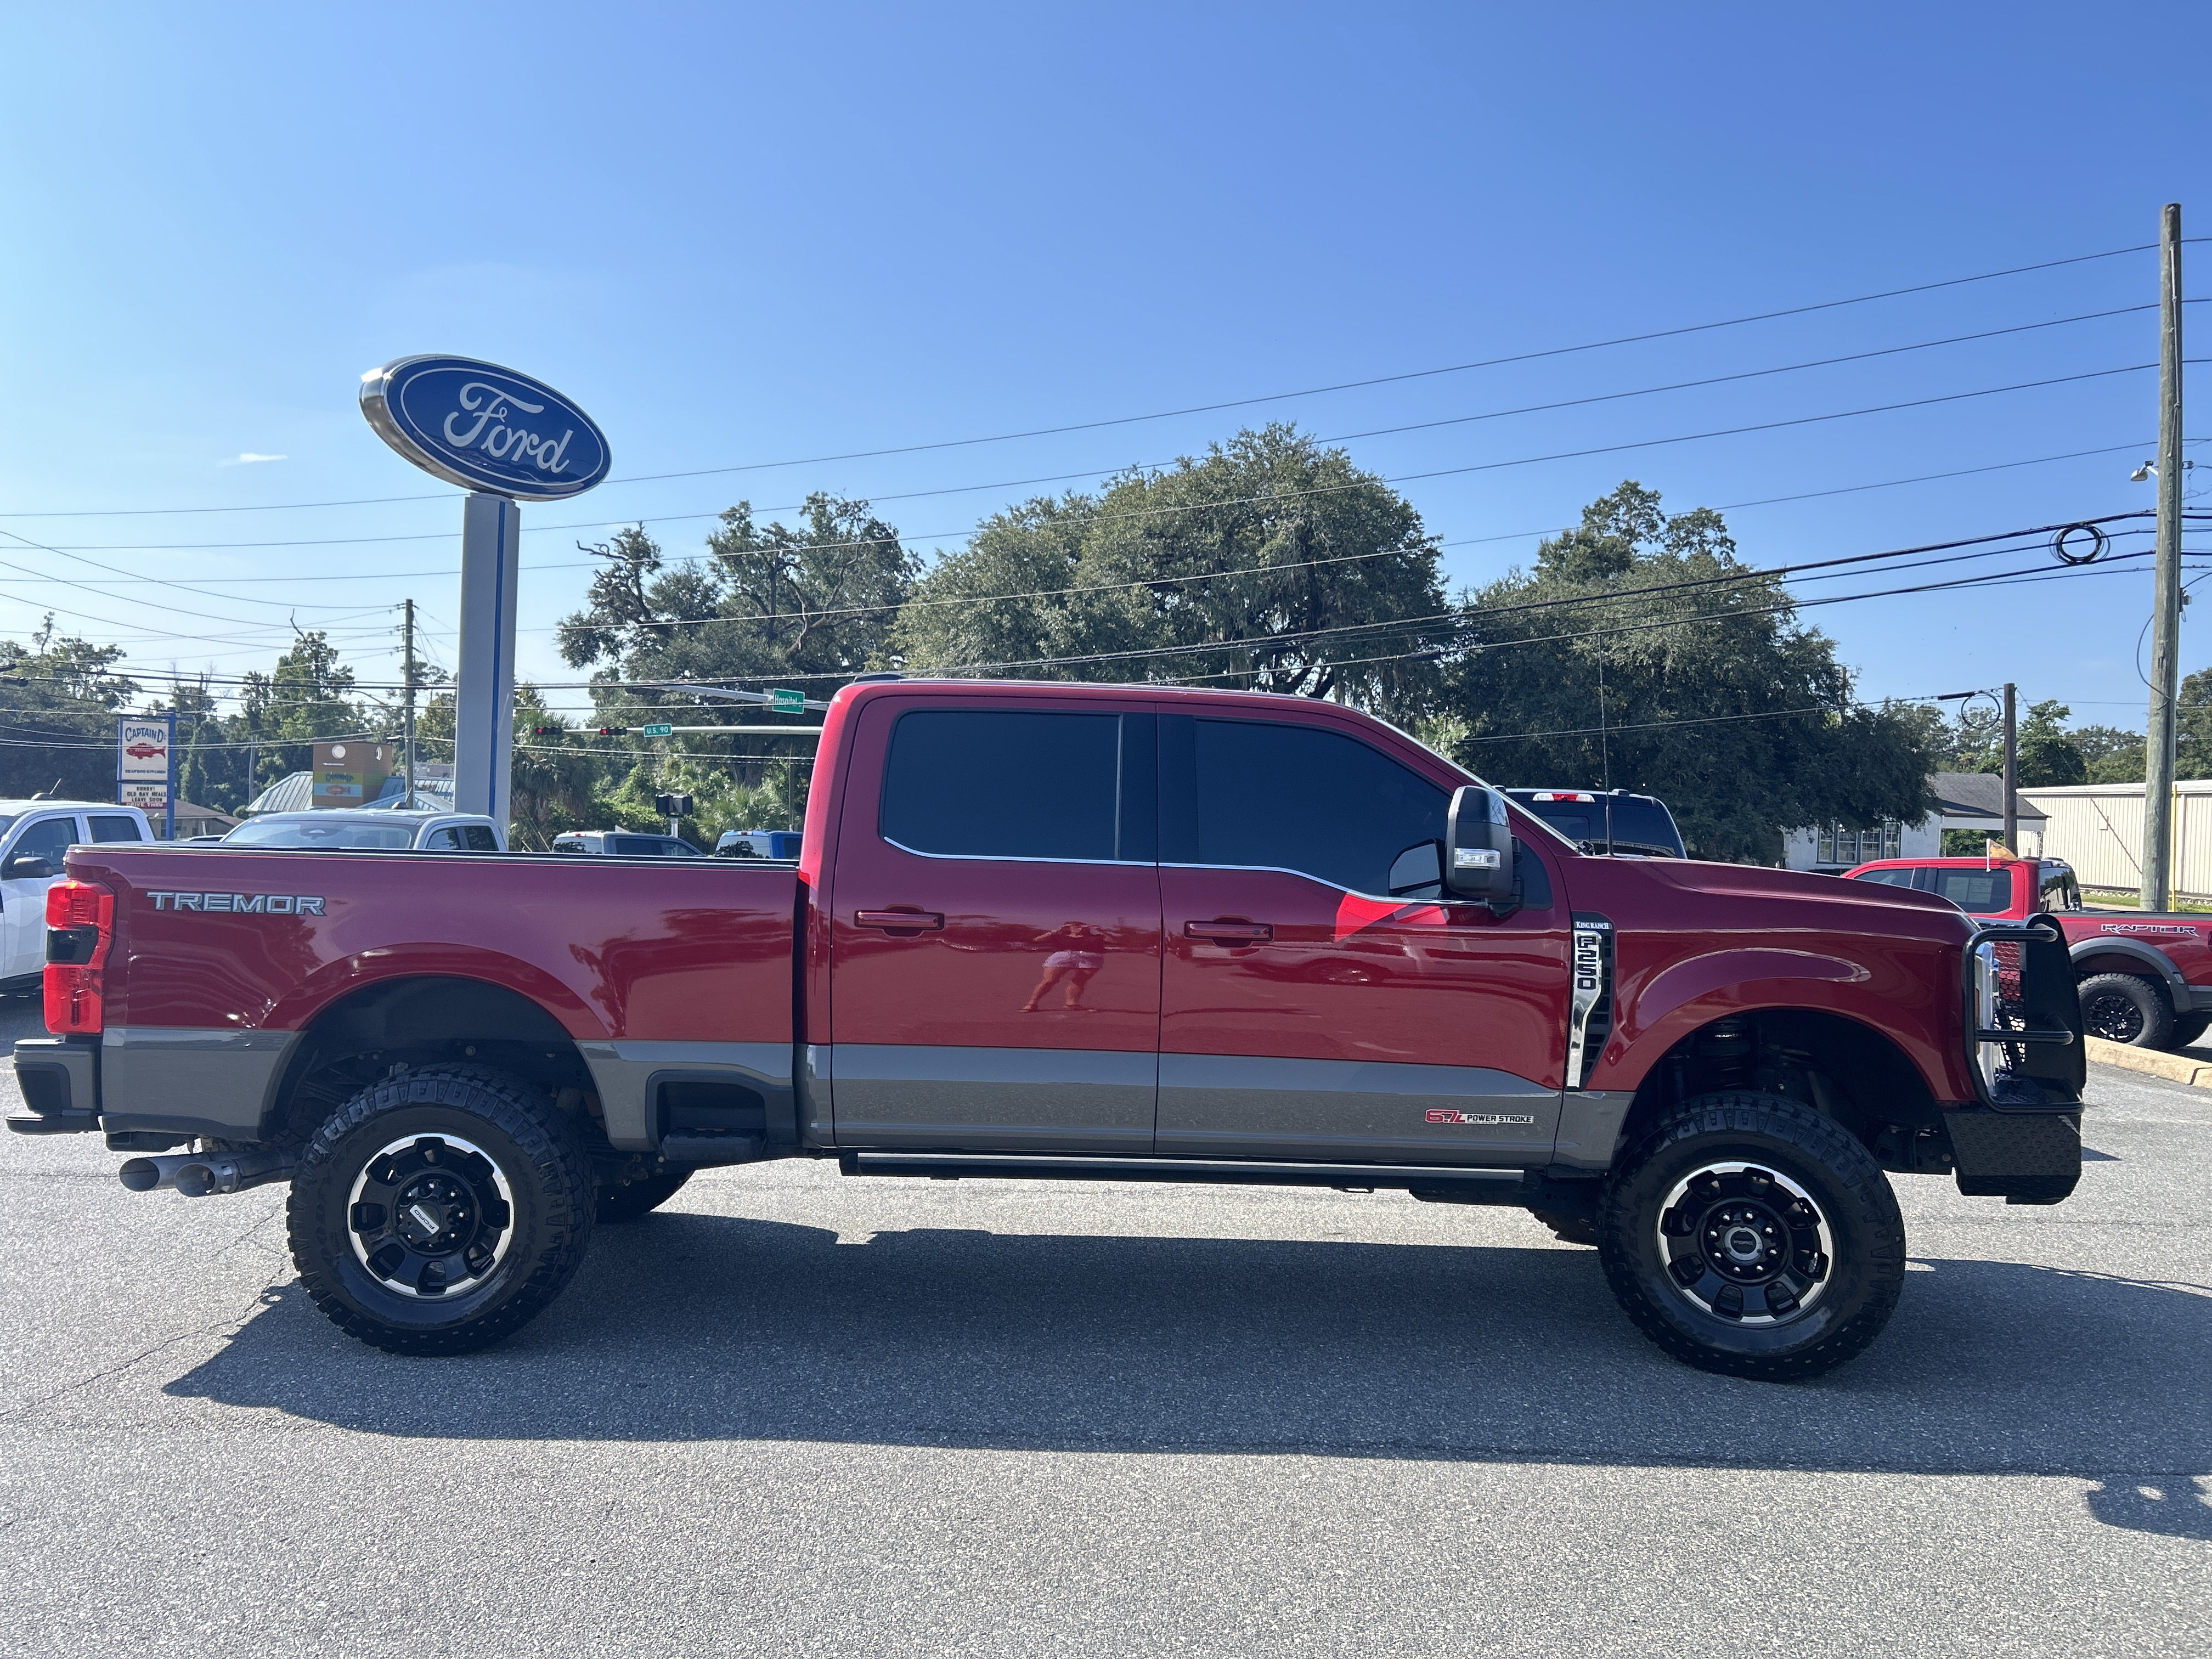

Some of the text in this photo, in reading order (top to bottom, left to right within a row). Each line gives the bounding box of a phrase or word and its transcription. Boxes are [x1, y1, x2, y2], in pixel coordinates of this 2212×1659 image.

[443, 382, 573, 474] Ford
[775, 695, 798, 707] Hospital
[125, 727, 157, 742] CAPTAIN
[146, 891, 328, 916] TREMOR
[2101, 923, 2200, 938] RAPTOR
[1577, 935, 1596, 990] F250
[1425, 1109, 1465, 1124] 6.7L
[414, 1209, 435, 1229] FORD
